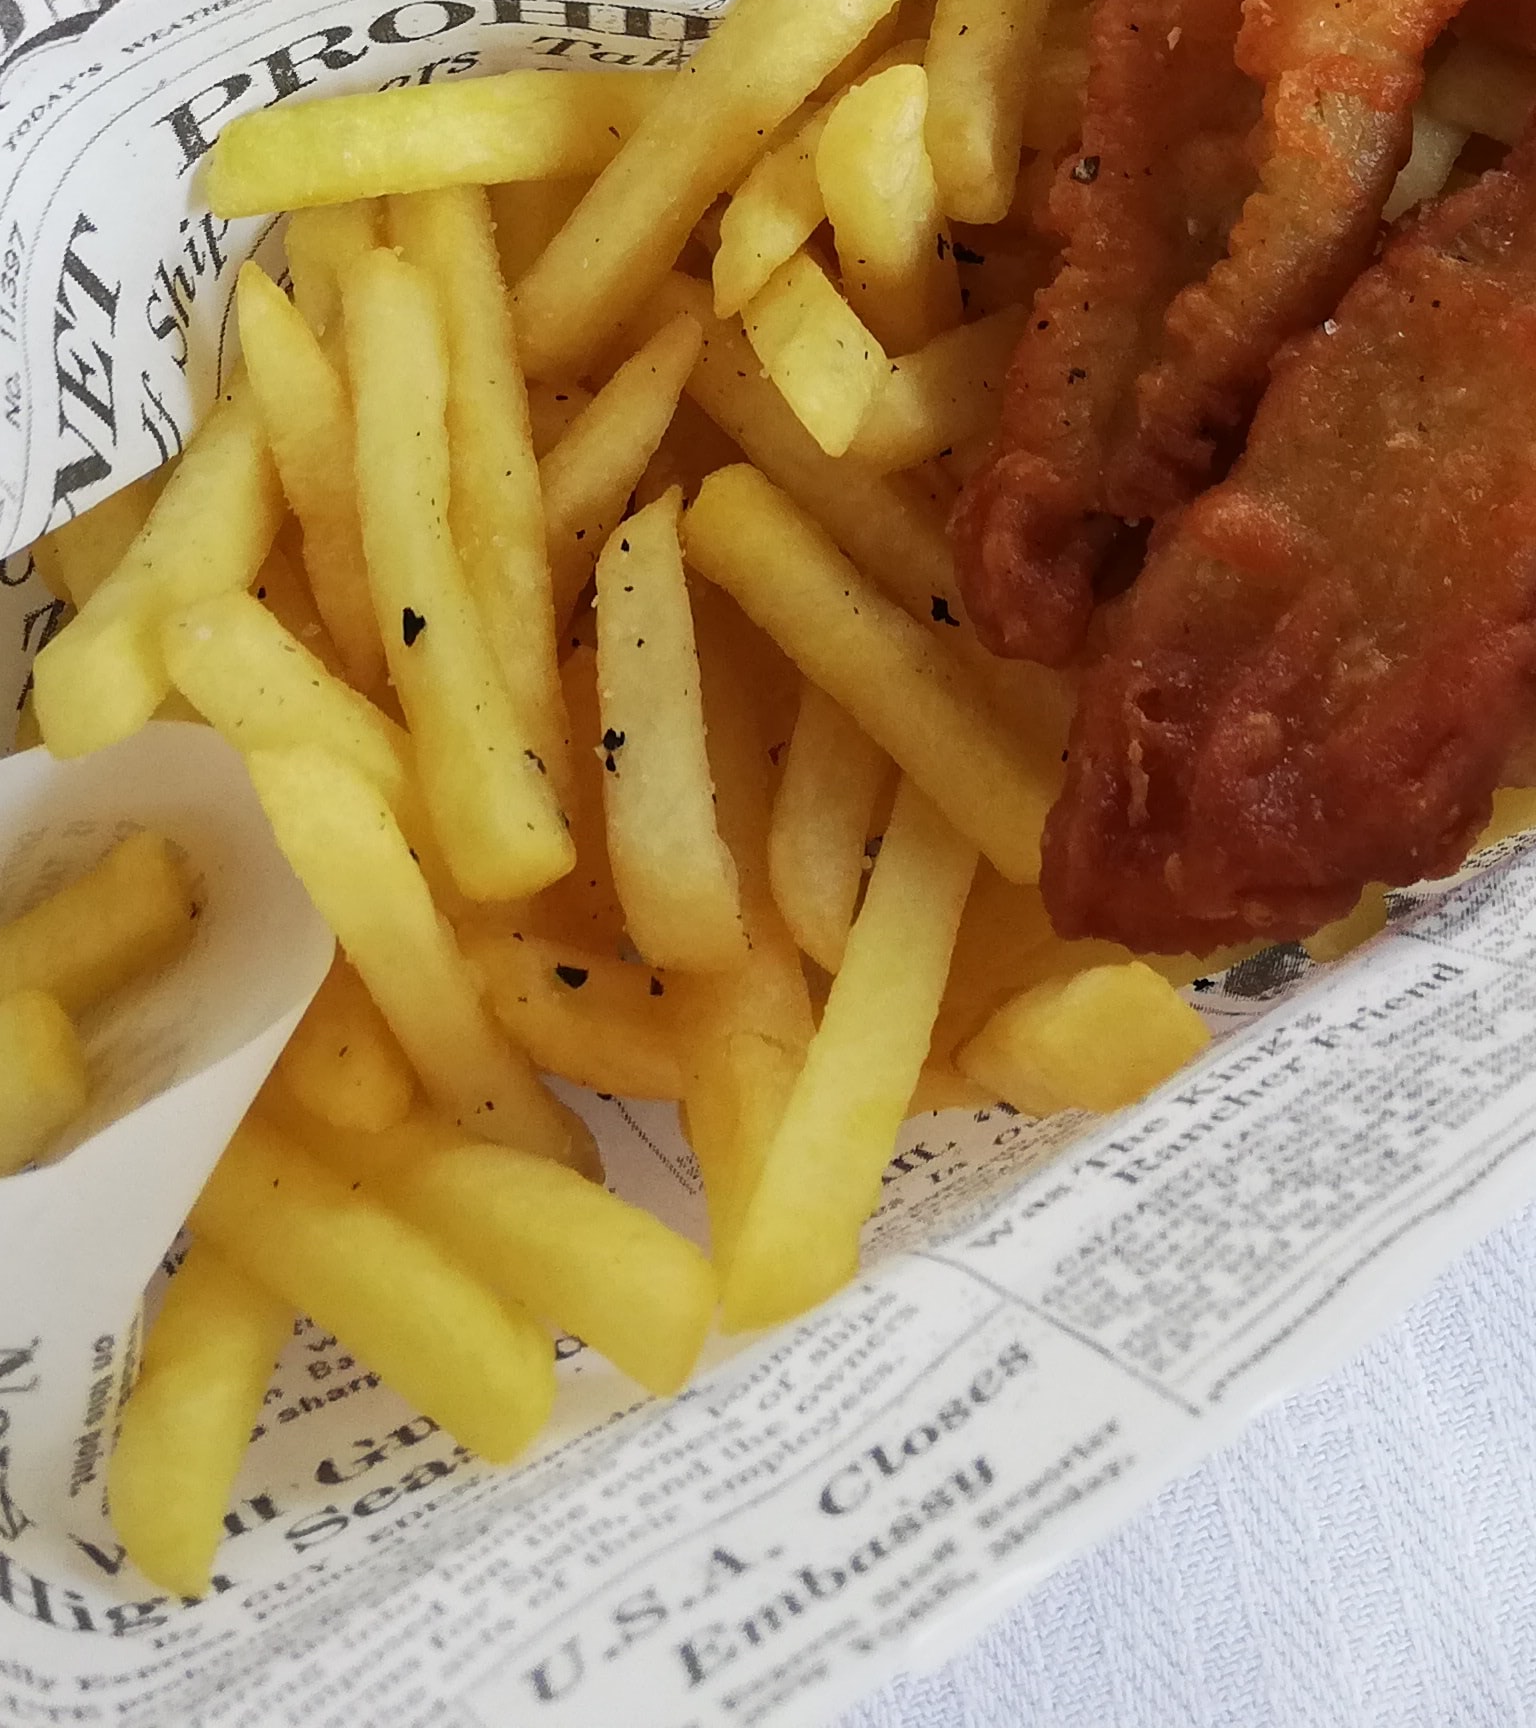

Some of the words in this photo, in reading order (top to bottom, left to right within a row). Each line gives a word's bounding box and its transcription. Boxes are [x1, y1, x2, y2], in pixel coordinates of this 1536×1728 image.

[1110, 1056, 1307, 1186] Rancher
[1306, 961, 1467, 1051] Friend
[817, 1340, 1033, 1518] Closes
[673, 1453, 997, 1690] Embassy
